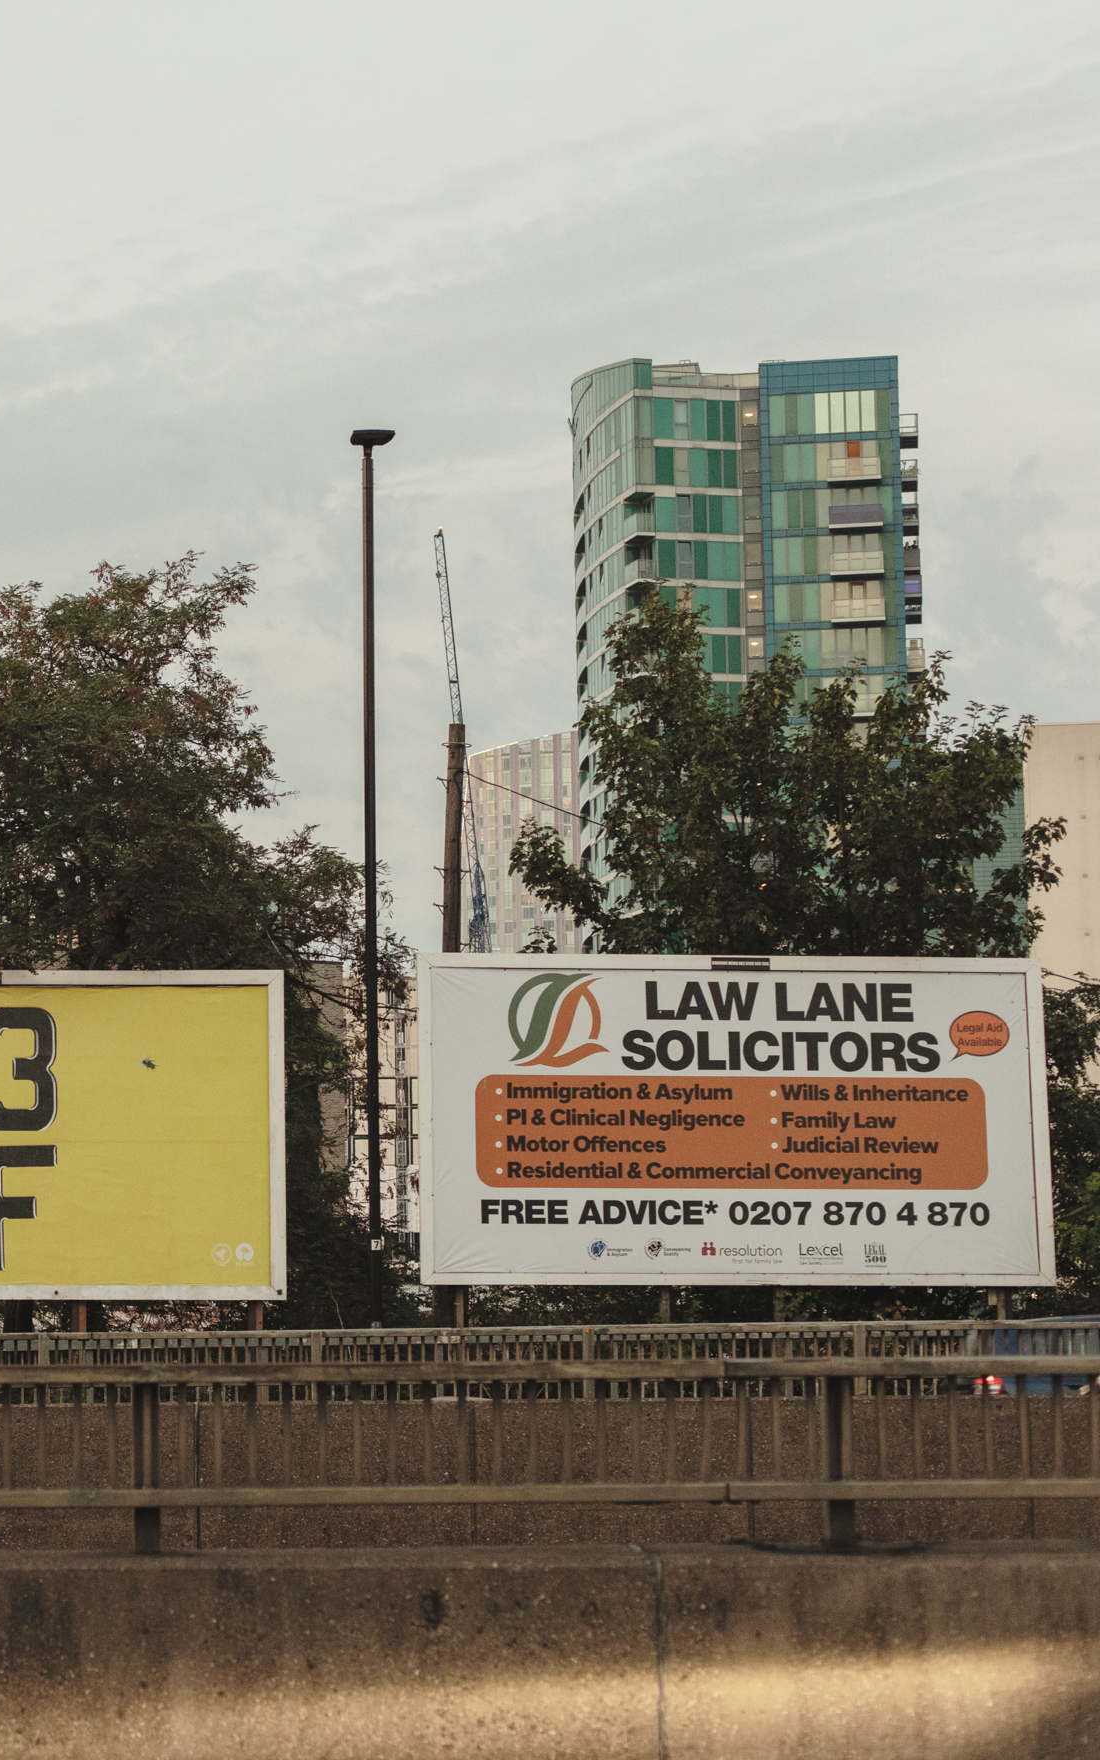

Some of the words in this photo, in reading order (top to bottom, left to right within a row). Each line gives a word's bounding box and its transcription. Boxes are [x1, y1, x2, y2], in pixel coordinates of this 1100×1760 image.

[645, 980, 759, 1020] LAW
[775, 982, 914, 1022] LANE
[956, 1023, 984, 1034] Legal
[986, 1023, 1003, 1032] Aid
[621, 1029, 941, 1073] SOLICITORS
[957, 1037, 1003, 1047] Available
[506, 1081, 632, 1104] Immigration
[636, 1082, 651, 1100] &
[654, 1083, 733, 1105] Asylum
[780, 1083, 830, 1101] Wills
[834, 1084, 849, 1101] &
[852, 1083, 969, 1102] Inheritance
[506, 1109, 527, 1126] PI
[530, 1108, 546, 1126] &
[549, 1108, 625, 1127] Clinical
[629, 1108, 746, 1132] Negligence
[781, 1110, 851, 1134] Family
[853, 1111, 897, 1129] Law
[506, 1134, 570, 1153] Motor
[573, 1134, 667, 1153] Offences
[781, 1135, 861, 1154] Judicial
[863, 1135, 940, 1154] Review
[506, 1160, 623, 1180] Residential
[626, 1161, 643, 1180] &
[645, 1161, 771, 1181] Commercial
[774, 1162, 923, 1186] Conveyancing
[480, 1199, 569, 1225] FREE
[728, 1201, 812, 1226] 0207
[822, 1202, 887, 1227] 870
[896, 1202, 918, 1227] 4
[927, 1202, 990, 1228] 870
[373, 1240, 380, 1249] 7
[719, 1244, 783, 1257] resolution
[799, 1243, 844, 1256] Lexcel
[754, 1258, 772, 1266] family
[864, 1255, 887, 1264] 500
